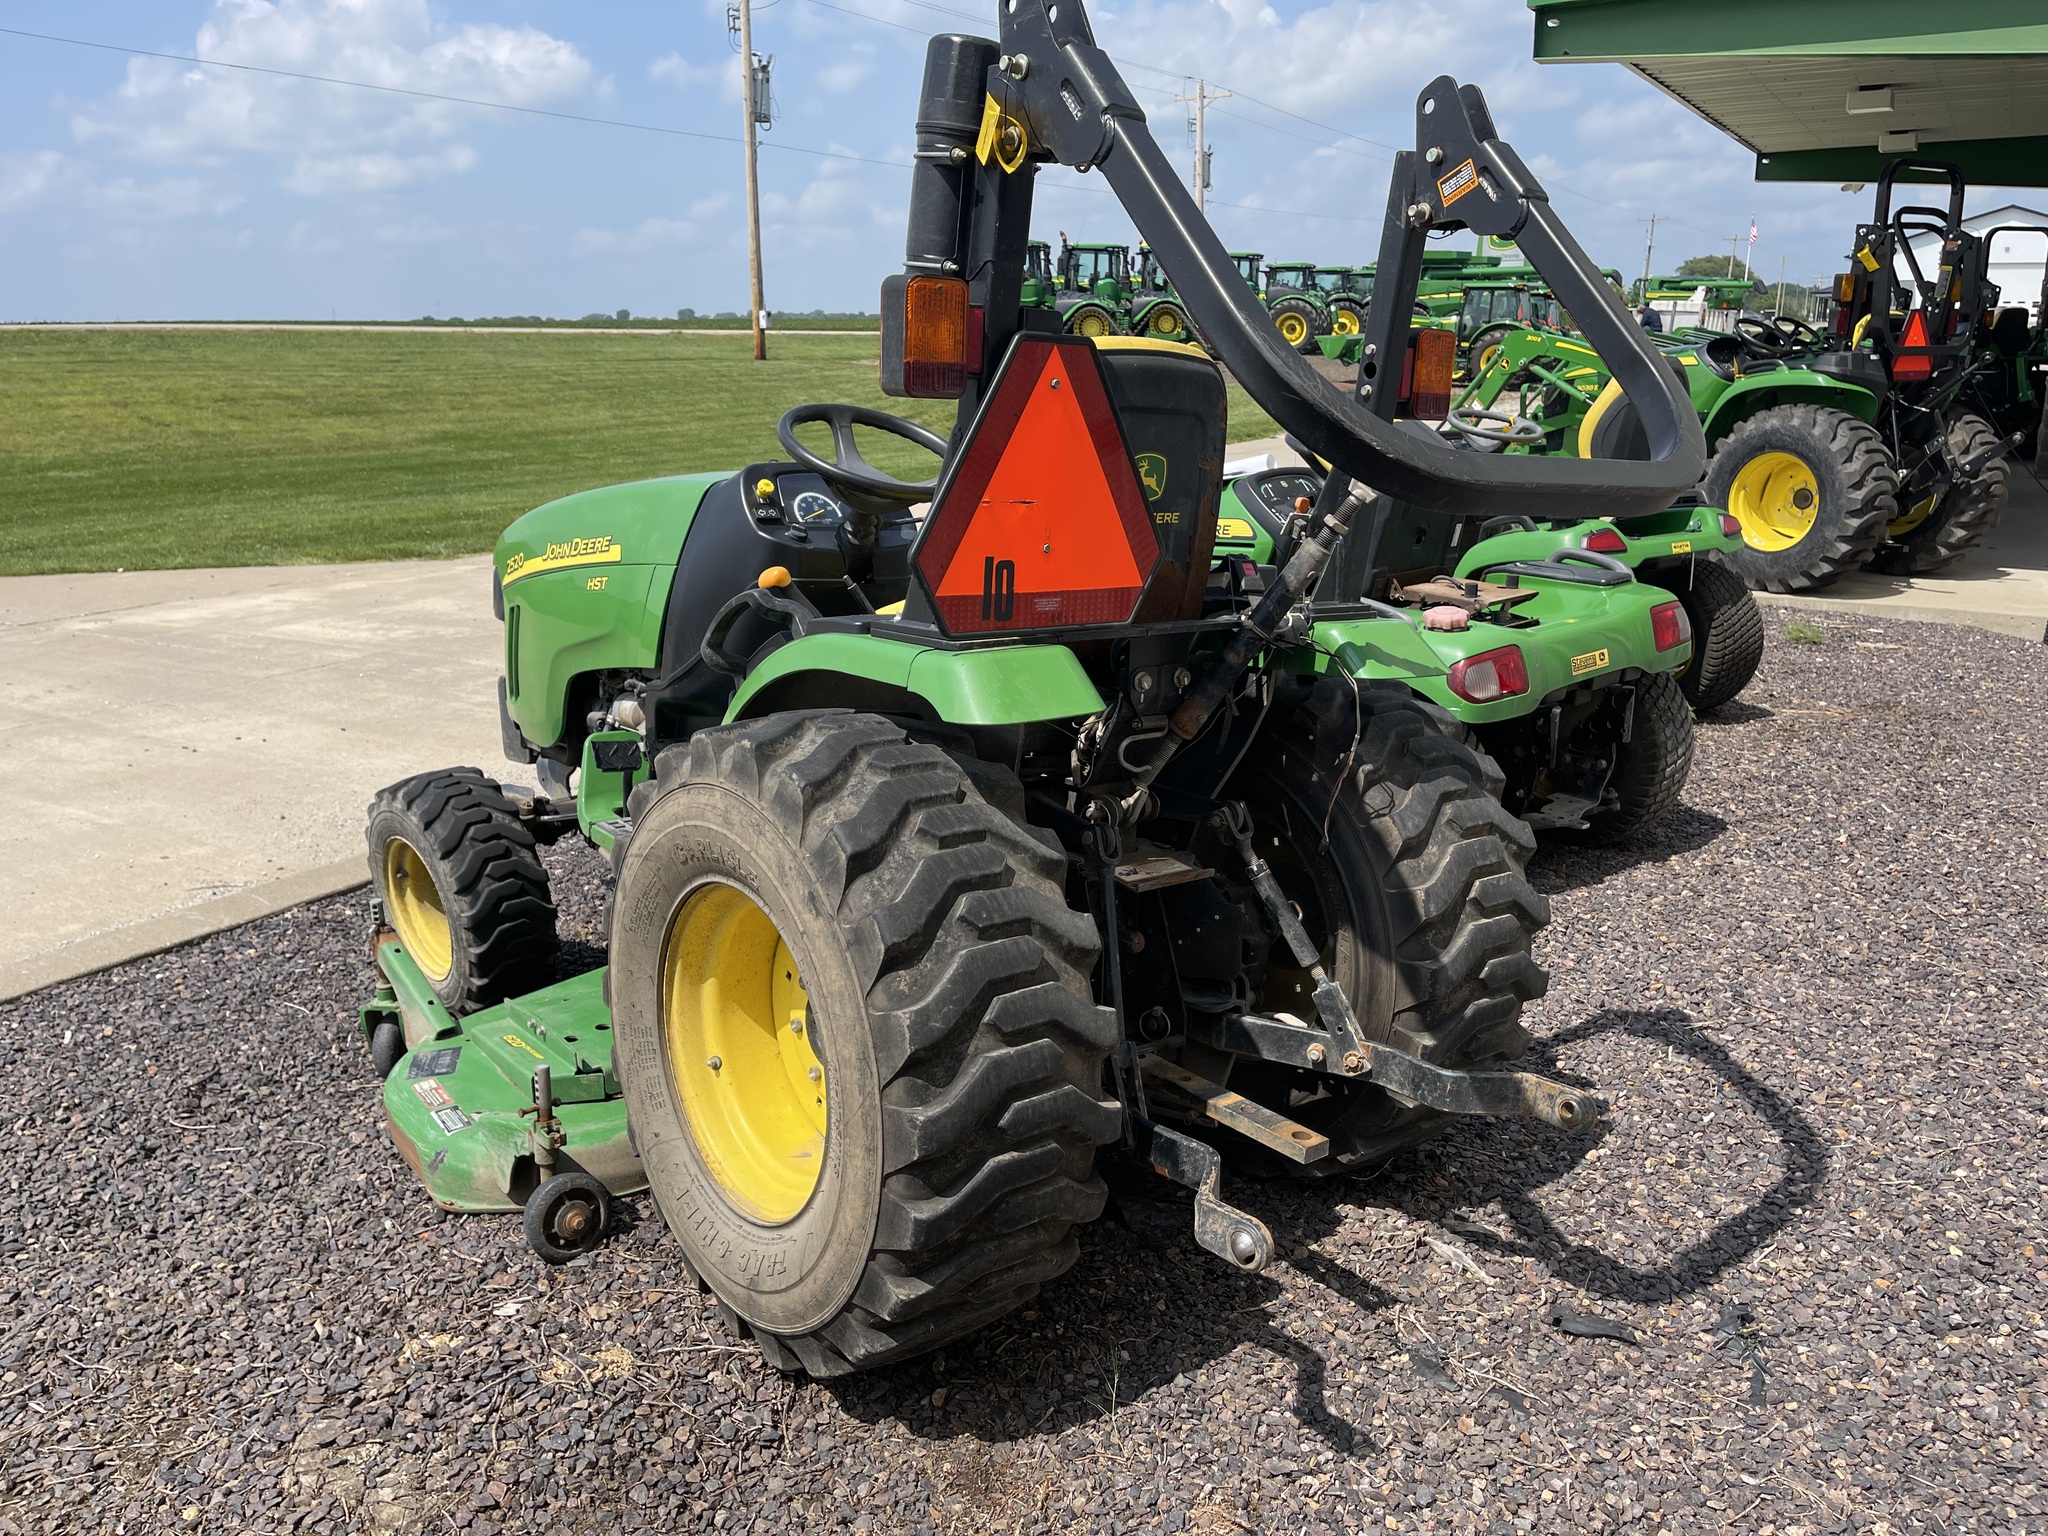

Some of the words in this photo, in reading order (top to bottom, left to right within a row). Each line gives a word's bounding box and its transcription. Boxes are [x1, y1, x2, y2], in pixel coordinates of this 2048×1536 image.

[1444, 183, 1472, 205] WARNING
[1153, 512, 1180, 524] ERE
[541, 541, 571, 561] JOHN
[571, 535, 613, 557] DEERE
[506, 551, 524, 574] 2520
[587, 576, 609, 591] HST
[981, 556, 1015, 622] 10
[673, 834, 761, 894] CARLISLE
